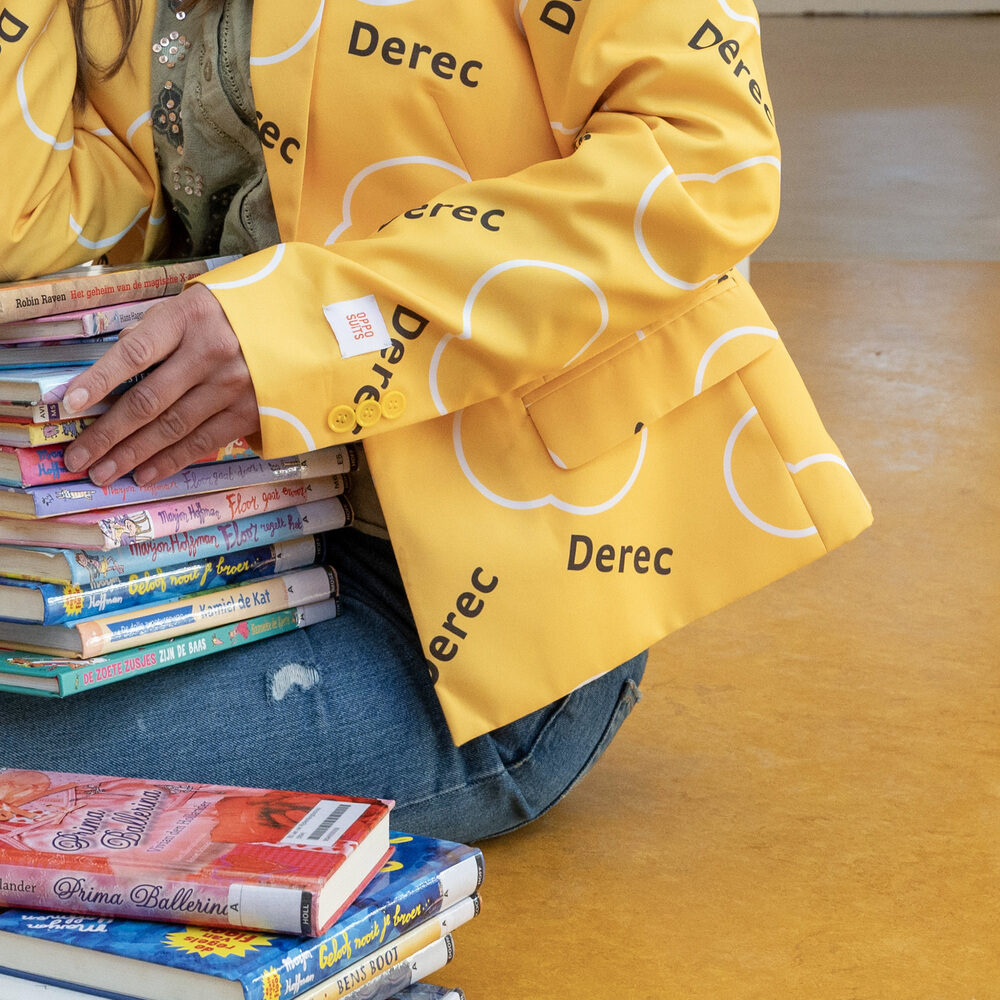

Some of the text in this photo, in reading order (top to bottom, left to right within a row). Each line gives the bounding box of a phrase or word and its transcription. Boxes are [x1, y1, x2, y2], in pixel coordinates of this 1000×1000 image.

[347, 19, 484, 89] Derec
[15, 295, 40, 309] Robin
[40, 292, 67, 306] Raven
[70, 287, 85, 301] Het
[85, 284, 115, 300] geheim
[116, 283, 132, 293] van
[132, 280, 143, 290] de
[356, 311, 375, 339] OPPO
[225, 491, 260, 520] Floor
[218, 519, 260, 552] Floor
[566, 532, 675, 577] Derec
[237, 593, 252, 609] de
[252, 588, 271, 605] Kat
[83, 638, 207, 686] DE ZOETE ZUSJES ZIJN DE BAAS
[52, 789, 163, 852] Prima Ballerina
[53, 876, 124, 907] Prima
[301, 903, 311, 926] HOLL
[318, 929, 352, 971] Geloof
[353, 923, 380, 950] nooit
[379, 913, 391, 945] je
[336, 945, 400, 996] BENS BOOT
